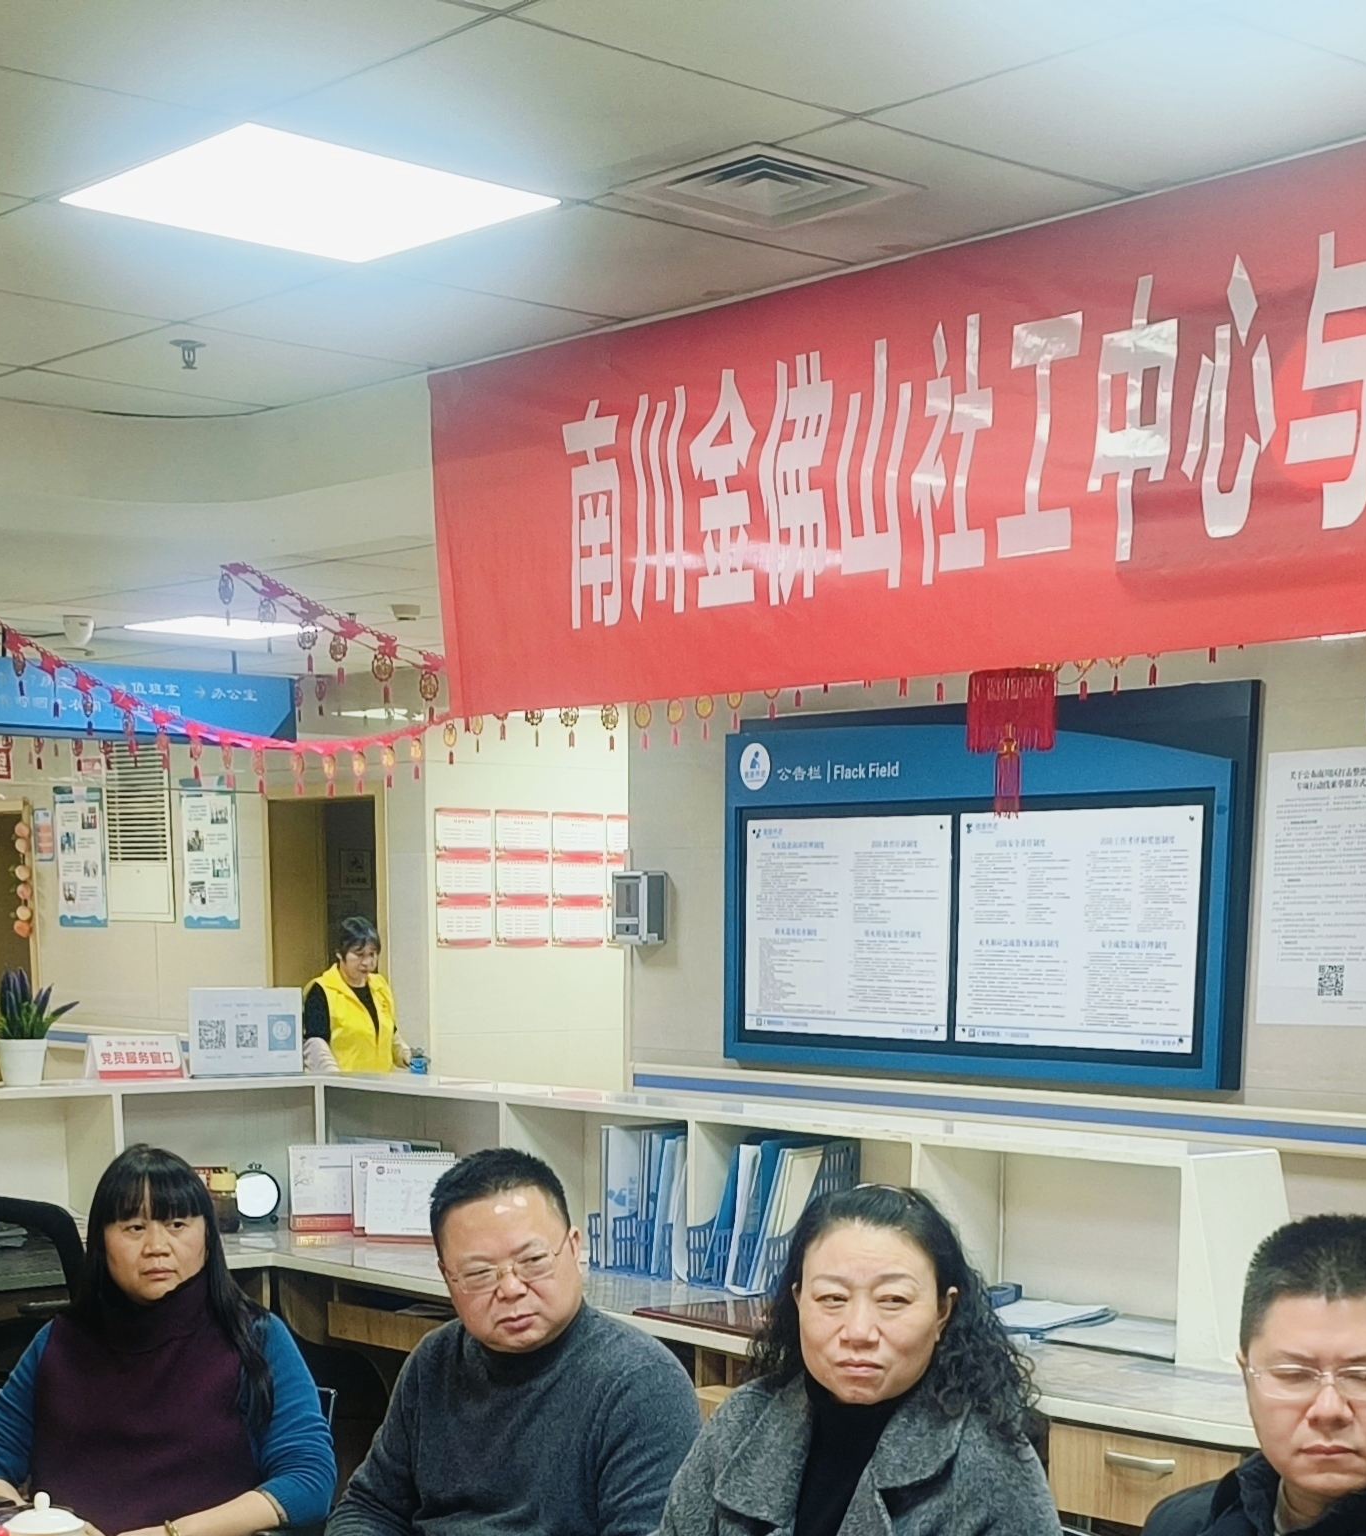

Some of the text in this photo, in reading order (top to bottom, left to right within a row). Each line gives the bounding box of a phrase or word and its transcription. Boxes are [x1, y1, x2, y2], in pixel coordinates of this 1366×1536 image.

[131, 682, 181, 697] 值班室
[211, 687, 258, 702] 办公室
[777, 760, 900, 781] 公告栏 Flack Field
[100, 1051, 175, 1065] 党员服务窗口
